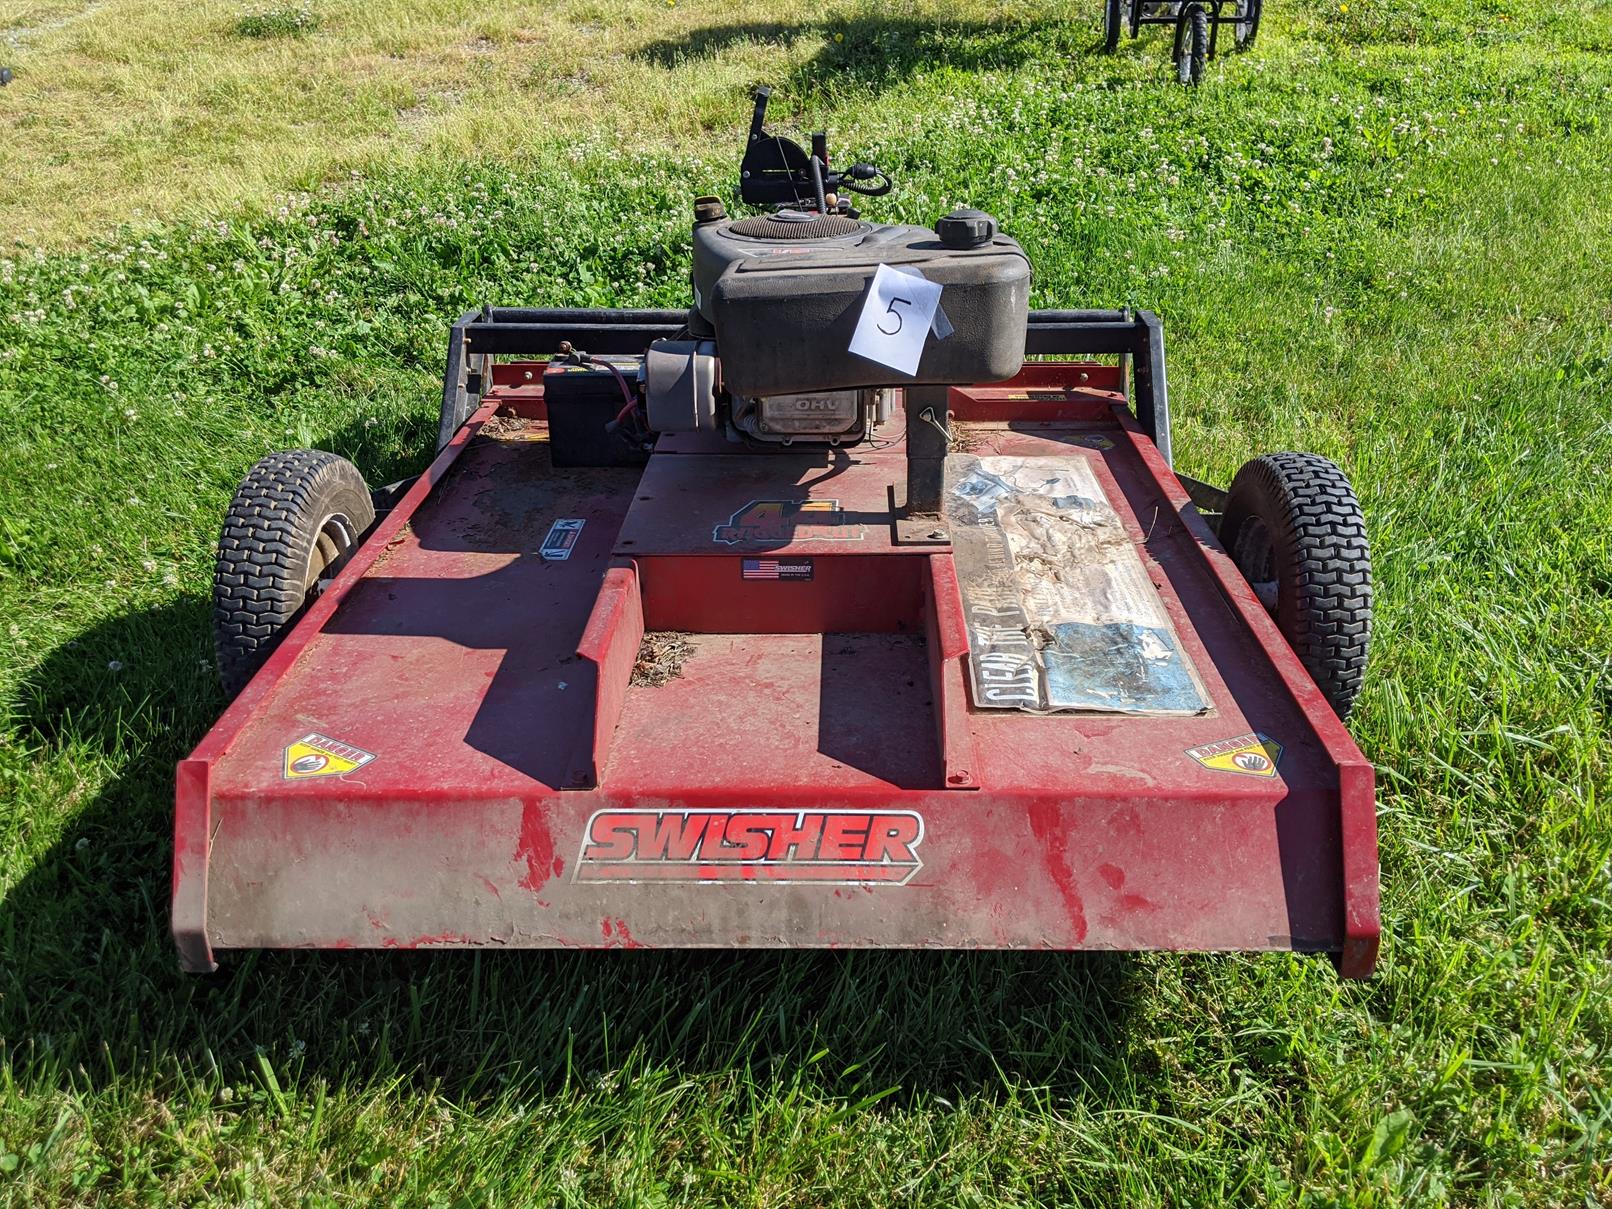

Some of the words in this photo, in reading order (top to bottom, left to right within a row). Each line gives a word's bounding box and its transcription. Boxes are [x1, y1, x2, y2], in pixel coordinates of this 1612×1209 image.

[876, 296, 912, 336] 5
[795, 399, 840, 411] OHV
[973, 623, 1028, 646] THE
[979, 652, 1037, 702] CLEAR
[583, 812, 922, 862] SWISHER
